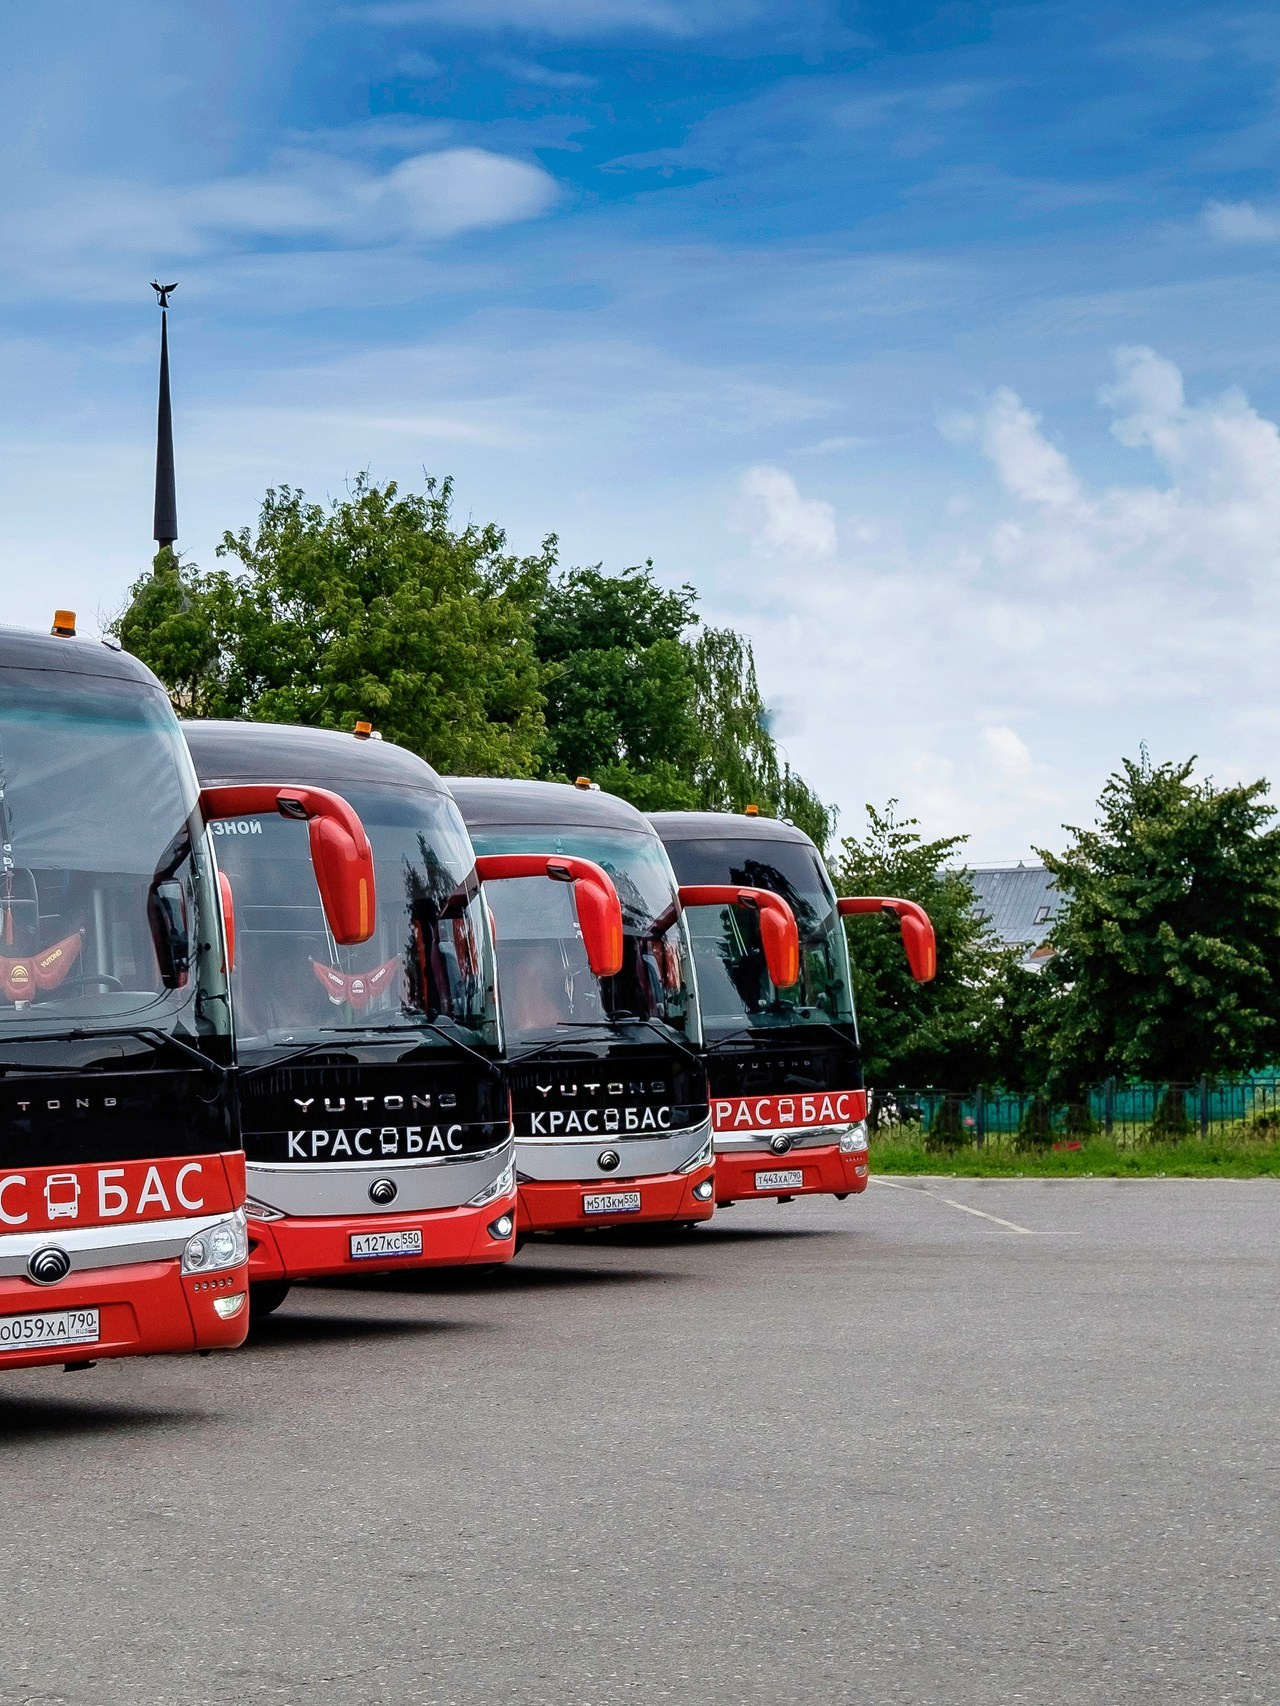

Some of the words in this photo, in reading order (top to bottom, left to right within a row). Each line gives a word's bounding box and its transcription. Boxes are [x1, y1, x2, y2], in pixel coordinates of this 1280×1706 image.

[209, 818, 263, 836] ЗНОЙ
[536, 1081, 666, 1098] YUTONG
[293, 1093, 457, 1113] YUTONG
[715, 1099, 772, 1128] РАС
[801, 1094, 851, 1122] БАС
[530, 1109, 599, 1135] КРАС
[624, 1106, 671, 1130] БАС
[287, 1128, 373, 1158] КРАС
[406, 1124, 463, 1153] БАС
[97, 1163, 204, 1217] БАС
[70, 1312, 94, 1330] 790
